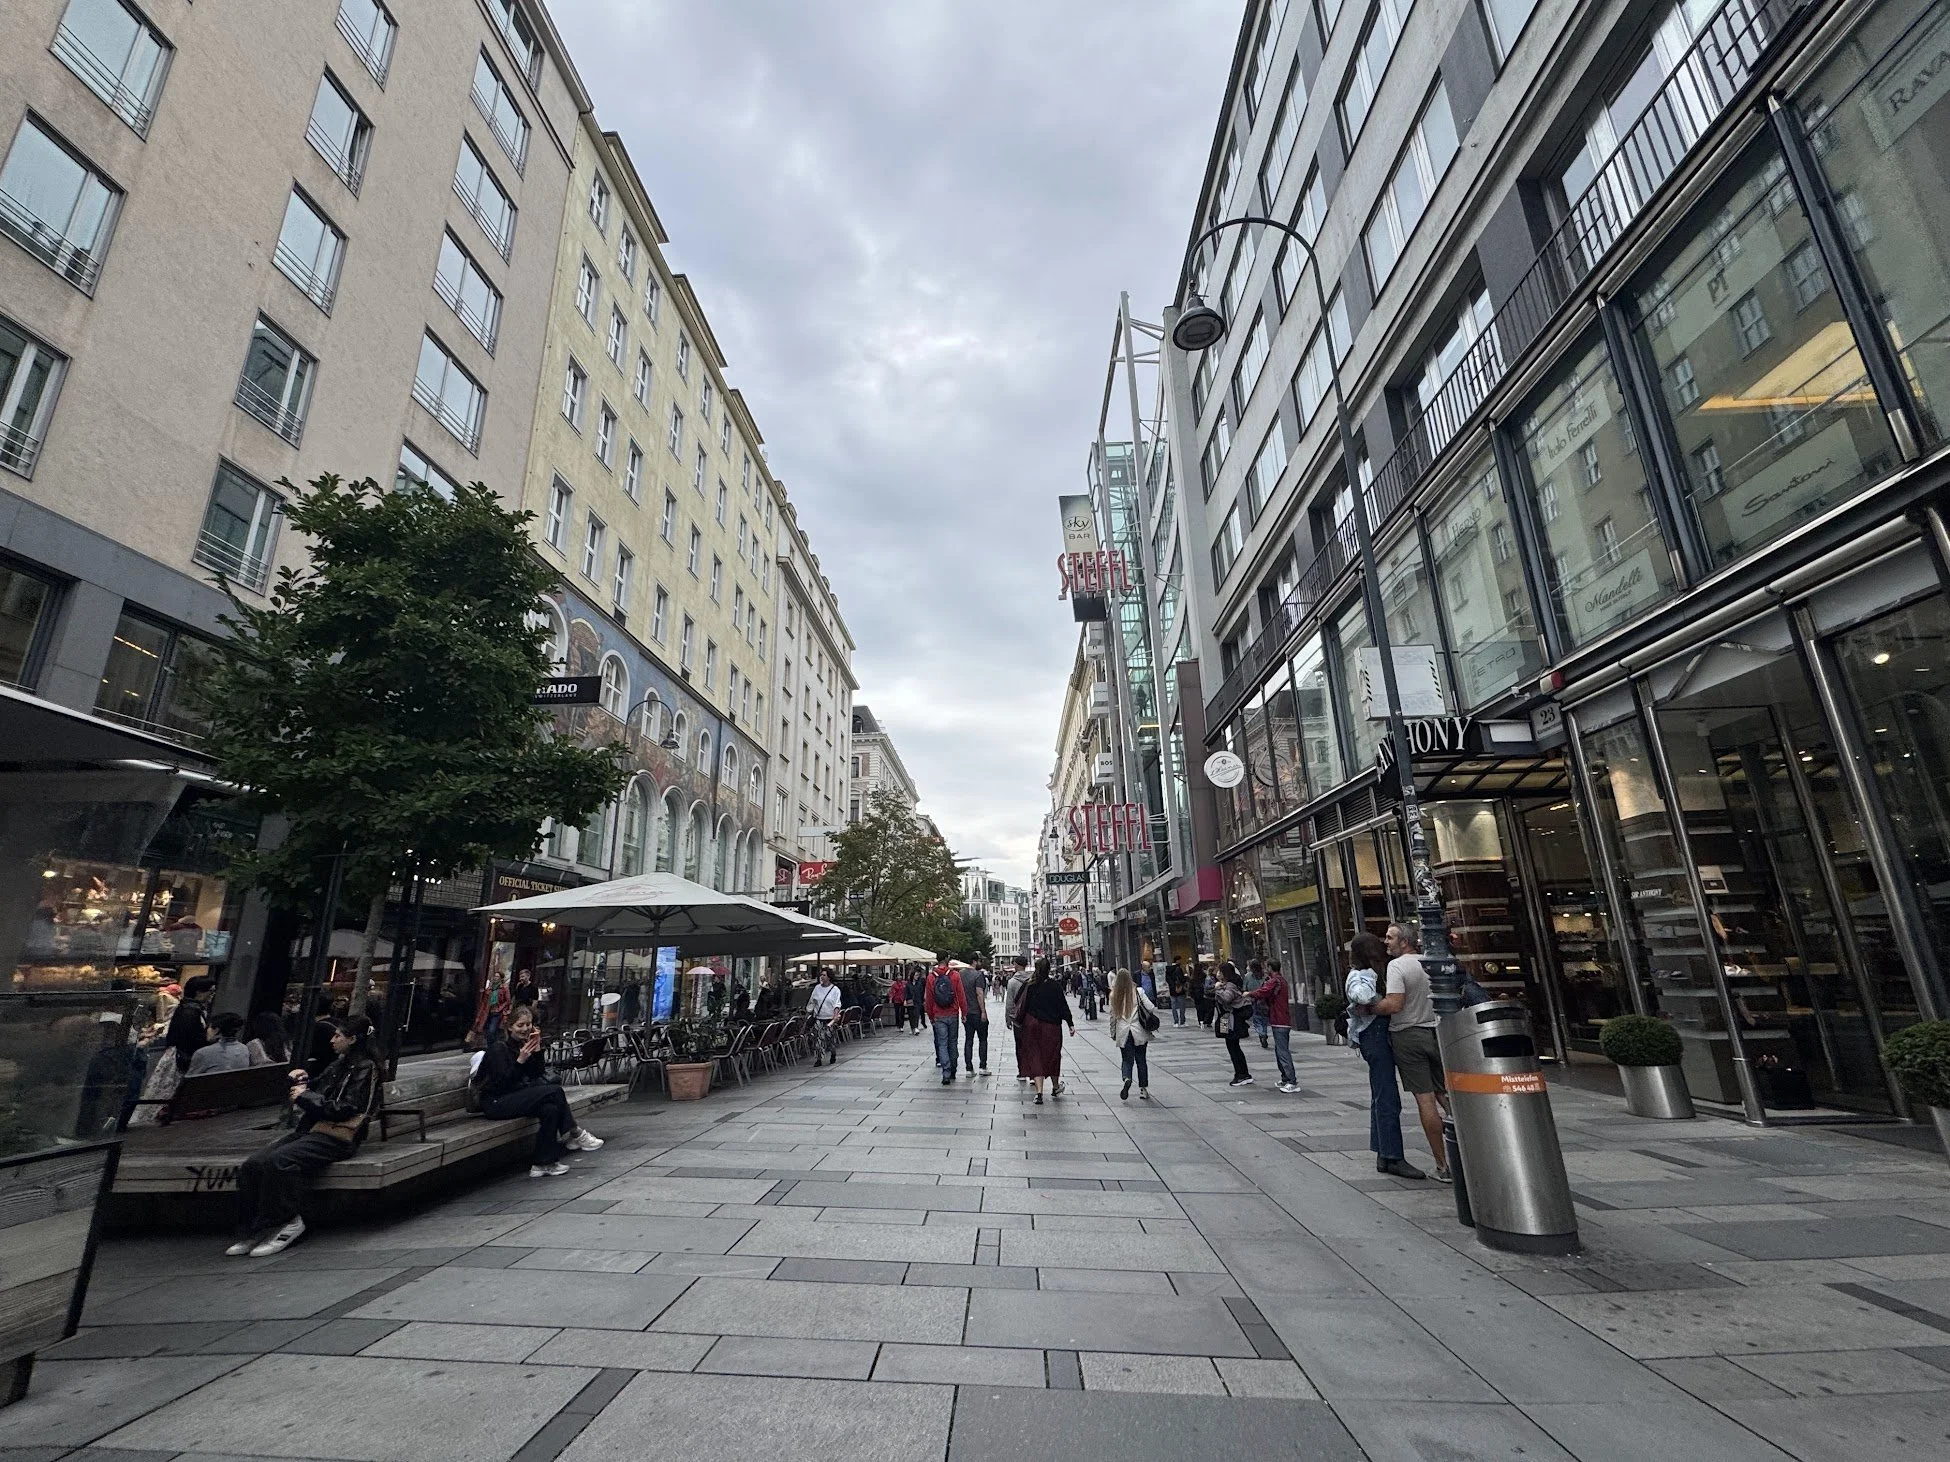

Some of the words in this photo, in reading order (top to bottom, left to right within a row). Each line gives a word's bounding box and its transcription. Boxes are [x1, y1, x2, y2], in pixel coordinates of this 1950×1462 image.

[1742, 457, 1835, 518] Santoni
[1066, 515, 1090, 529] sky
[1057, 549, 1133, 595] STEFFL
[1540, 706, 1556, 726] 23
[1069, 802, 1153, 854] STEFFL
[499, 875, 531, 890] OFFICIAL
[531, 881, 554, 893] TICKET
